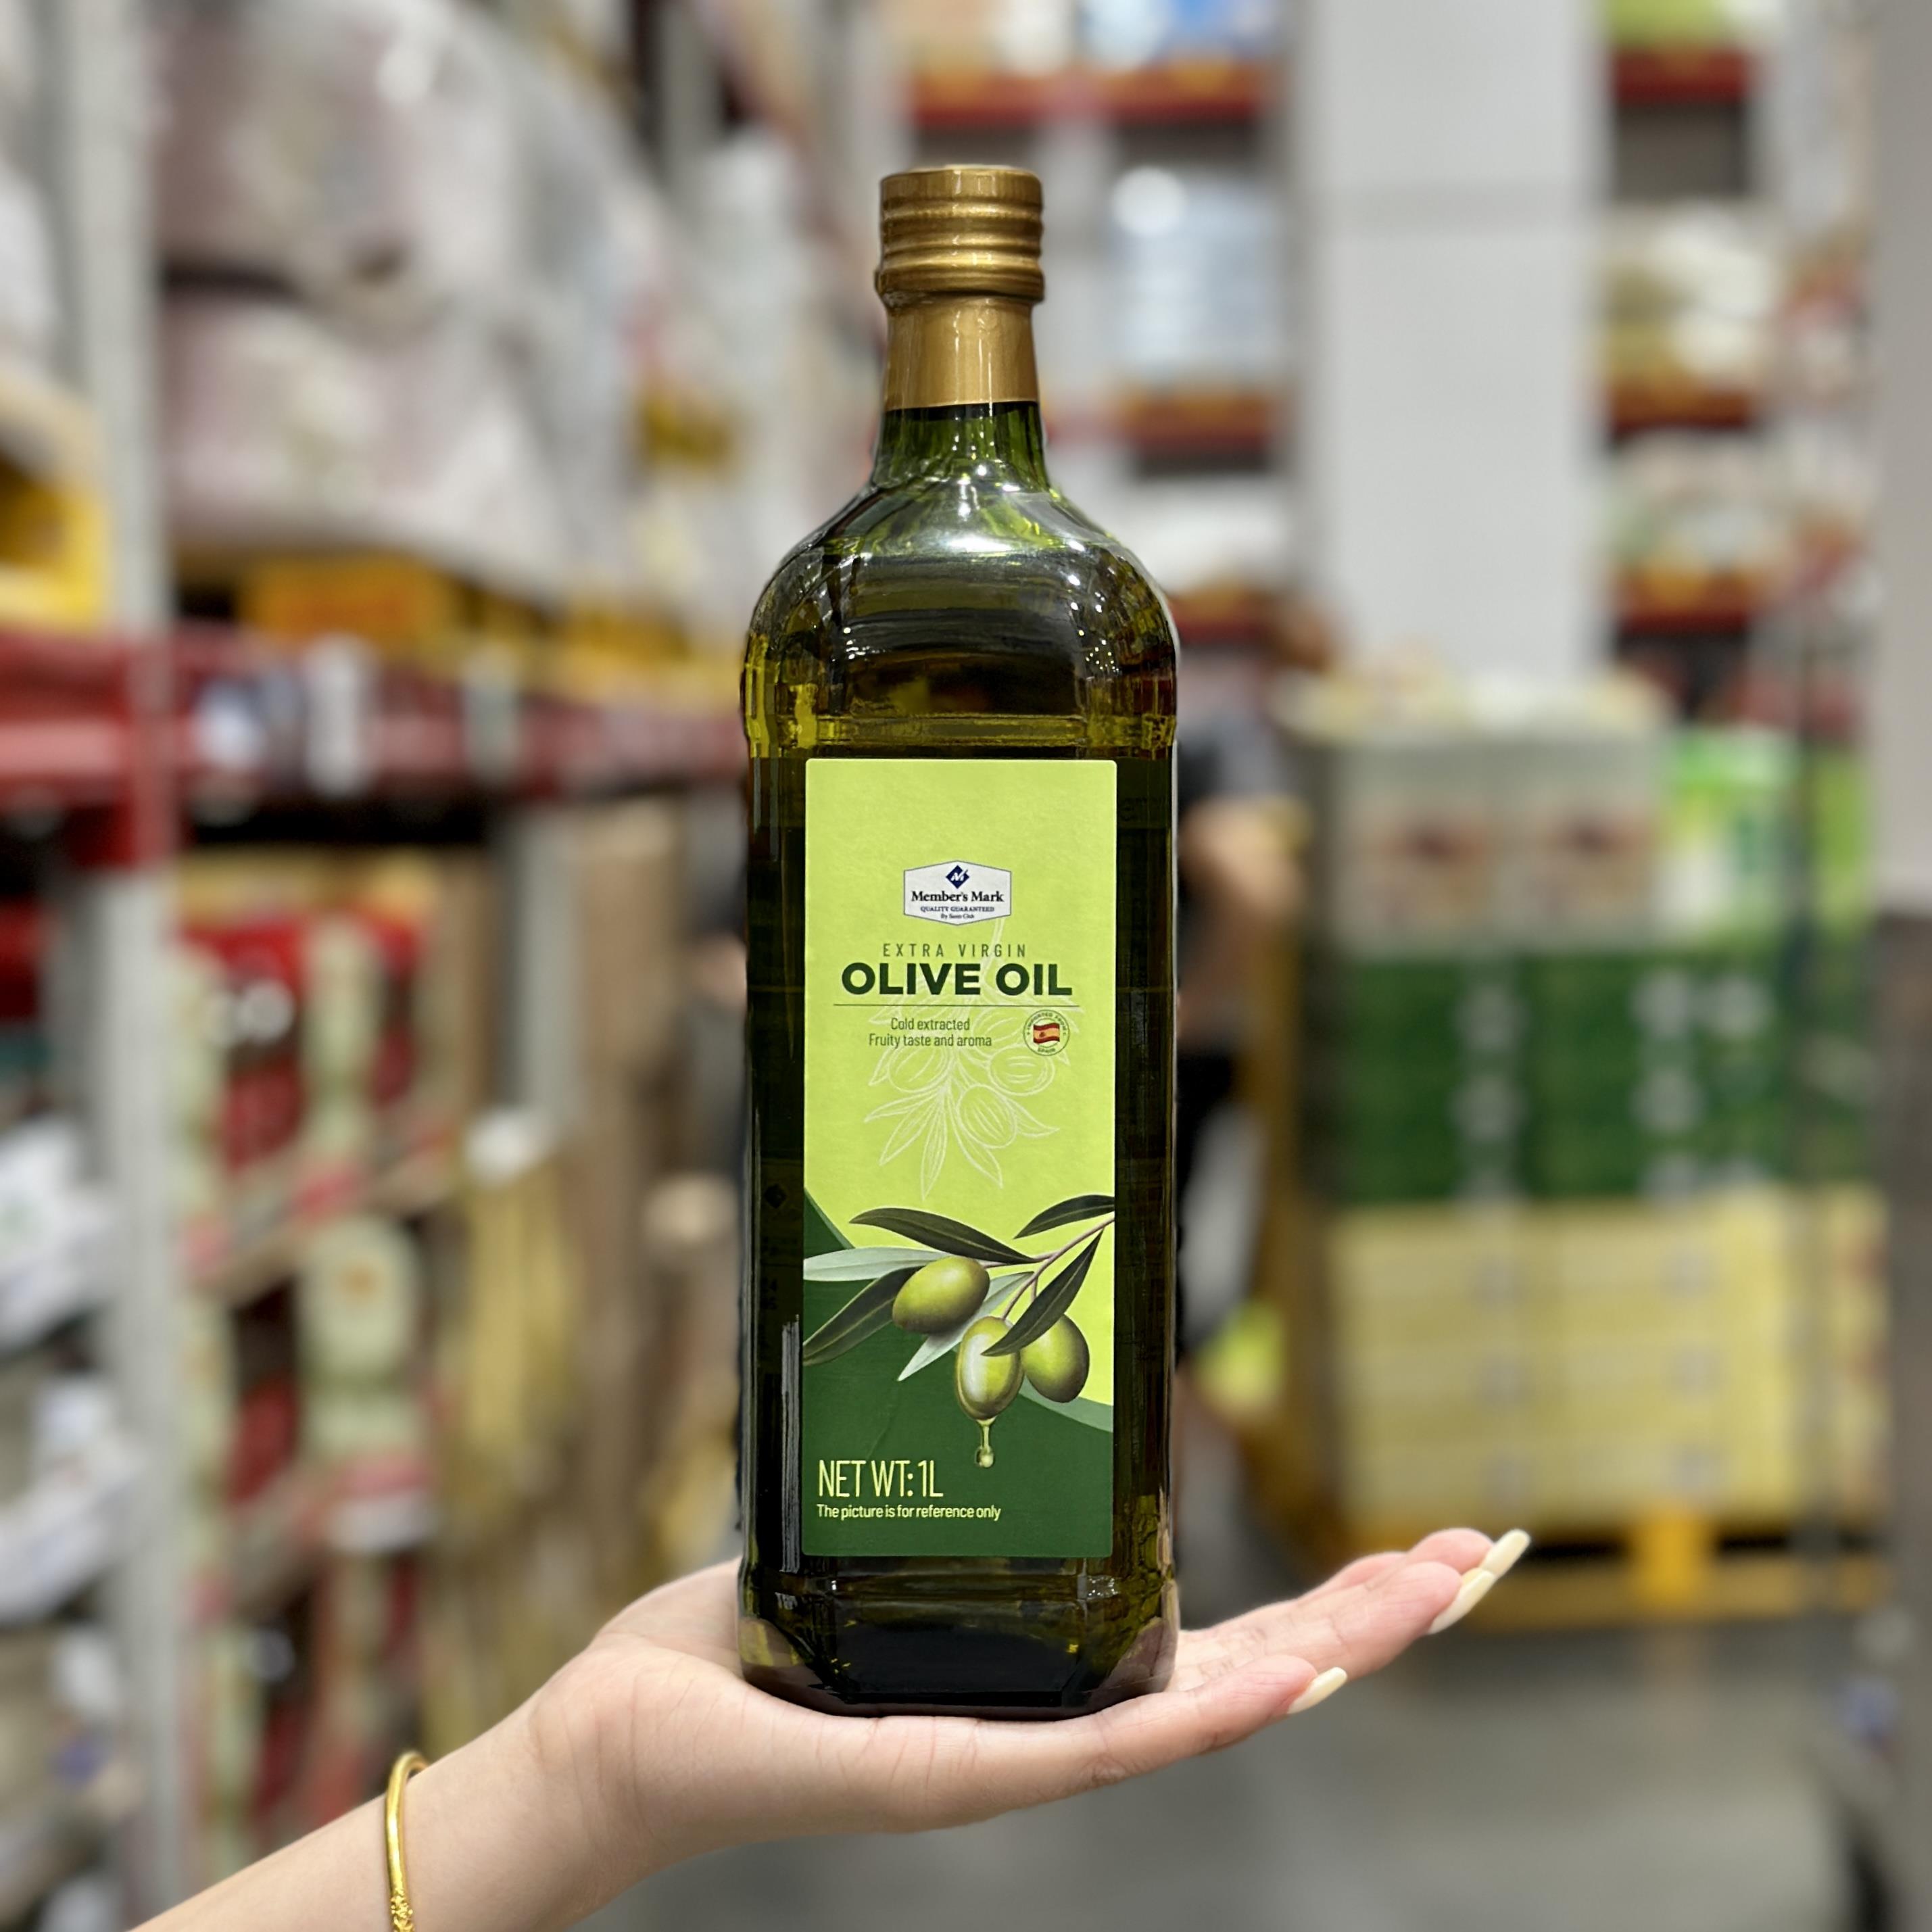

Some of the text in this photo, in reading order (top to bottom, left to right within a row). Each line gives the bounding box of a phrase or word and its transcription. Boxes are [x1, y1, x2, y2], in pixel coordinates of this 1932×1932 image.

[911, 890, 1004, 902] Member's Mark
[883, 944, 1025, 957] EXTRA VIRGIN
[842, 962, 1072, 996] OLIVE OIL
[891, 1017, 970, 1030] Cold extracted
[869, 1034, 992, 1048] Fruity taste and aroma
[819, 1459, 944, 1497] NET WT: 1L
[817, 1504, 1001, 1521] The picture is for reference only
